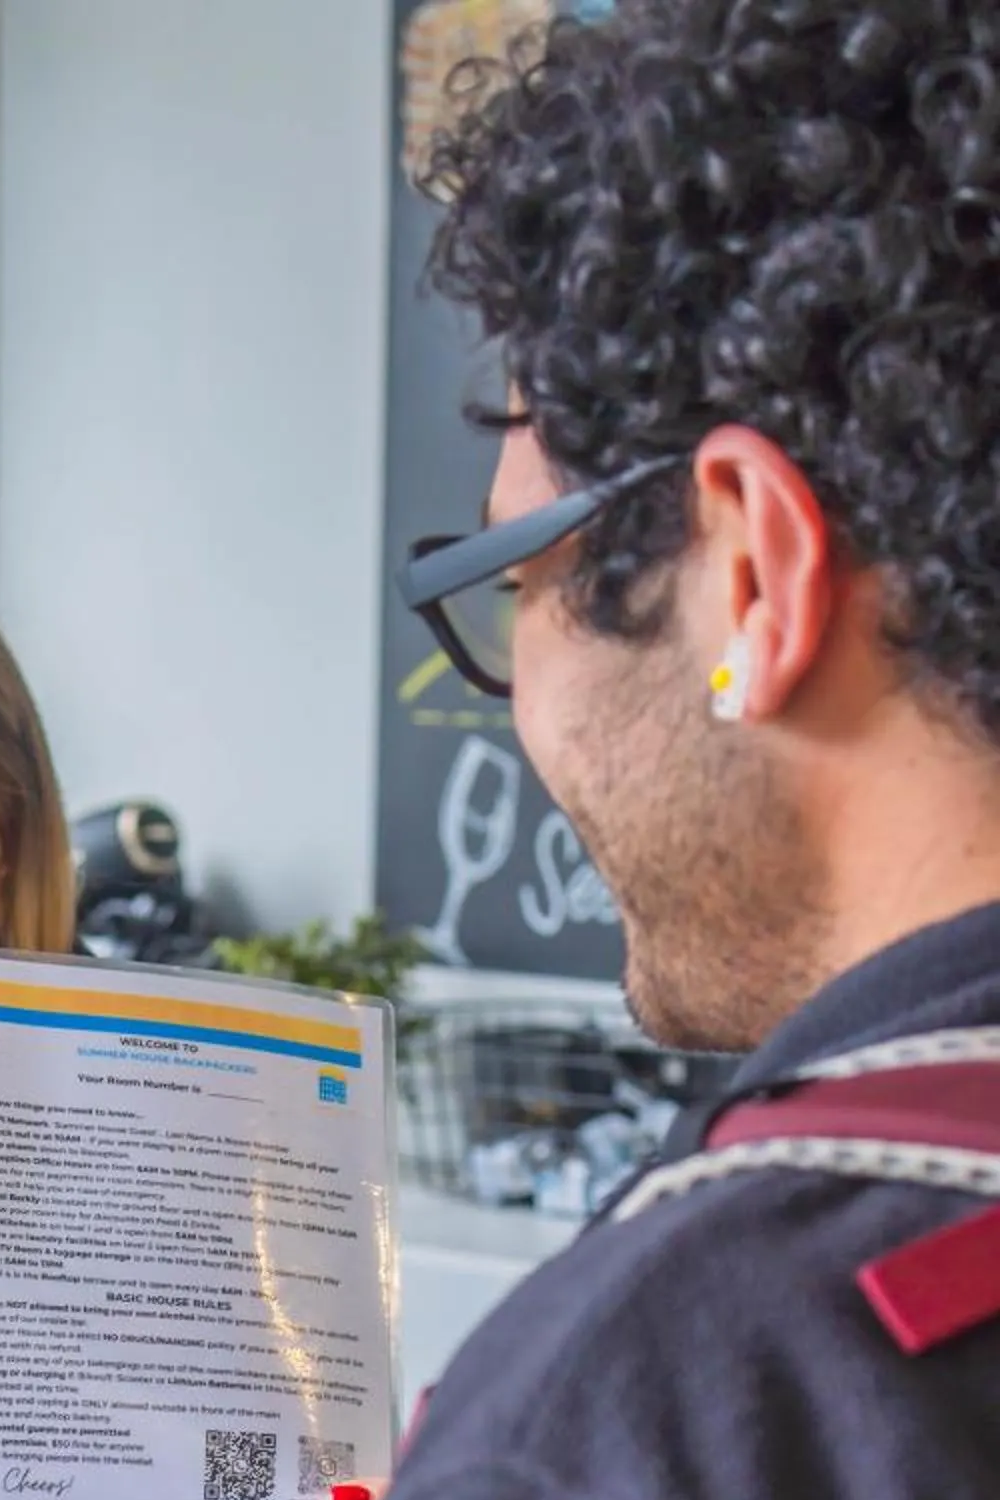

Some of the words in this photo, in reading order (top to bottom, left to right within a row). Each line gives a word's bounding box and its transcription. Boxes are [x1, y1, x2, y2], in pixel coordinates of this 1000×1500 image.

[119, 1035, 179, 1052] WELCOME
[182, 1043, 198, 1053] TO
[77, 1072, 104, 1085] Your
[107, 1075, 140, 1088] Room
[143, 1078, 189, 1092] Number
[191, 1085, 201, 1093] is
[47, 1104, 66, 1114] you
[95, 1108, 104, 1116] to
[105, 1291, 142, 1303] BASIC
[147, 1294, 191, 1307] HOUSE
[193, 1298, 232, 1311] RULES
[79, 1426, 130, 1439] permitted
